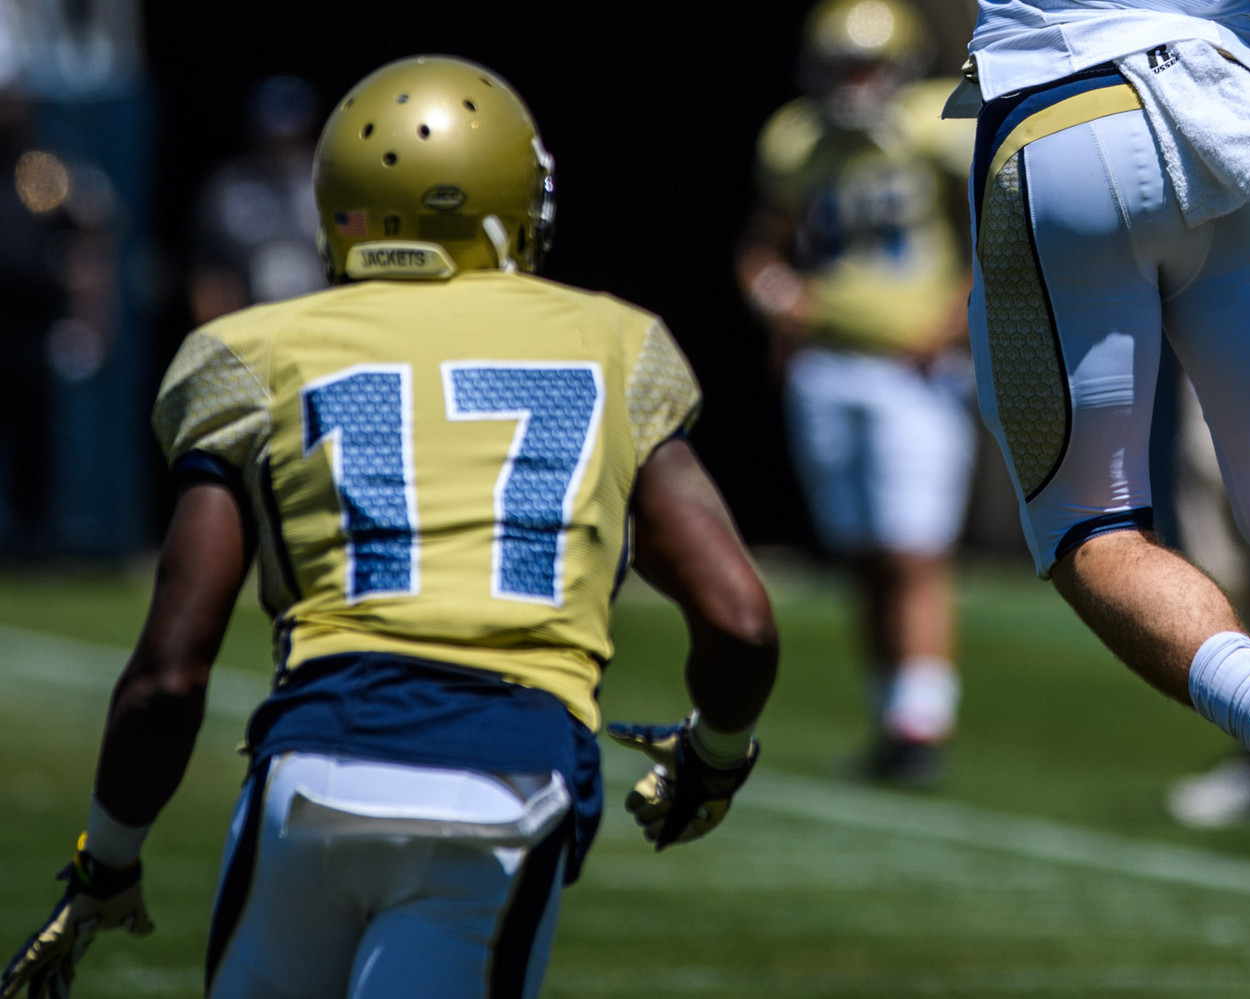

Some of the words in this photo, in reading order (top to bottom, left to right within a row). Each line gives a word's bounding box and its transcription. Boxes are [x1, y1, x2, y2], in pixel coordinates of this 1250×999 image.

[384, 214, 401, 236] 17
[361, 249, 426, 268] JACKETS
[301, 360, 605, 607] 17
